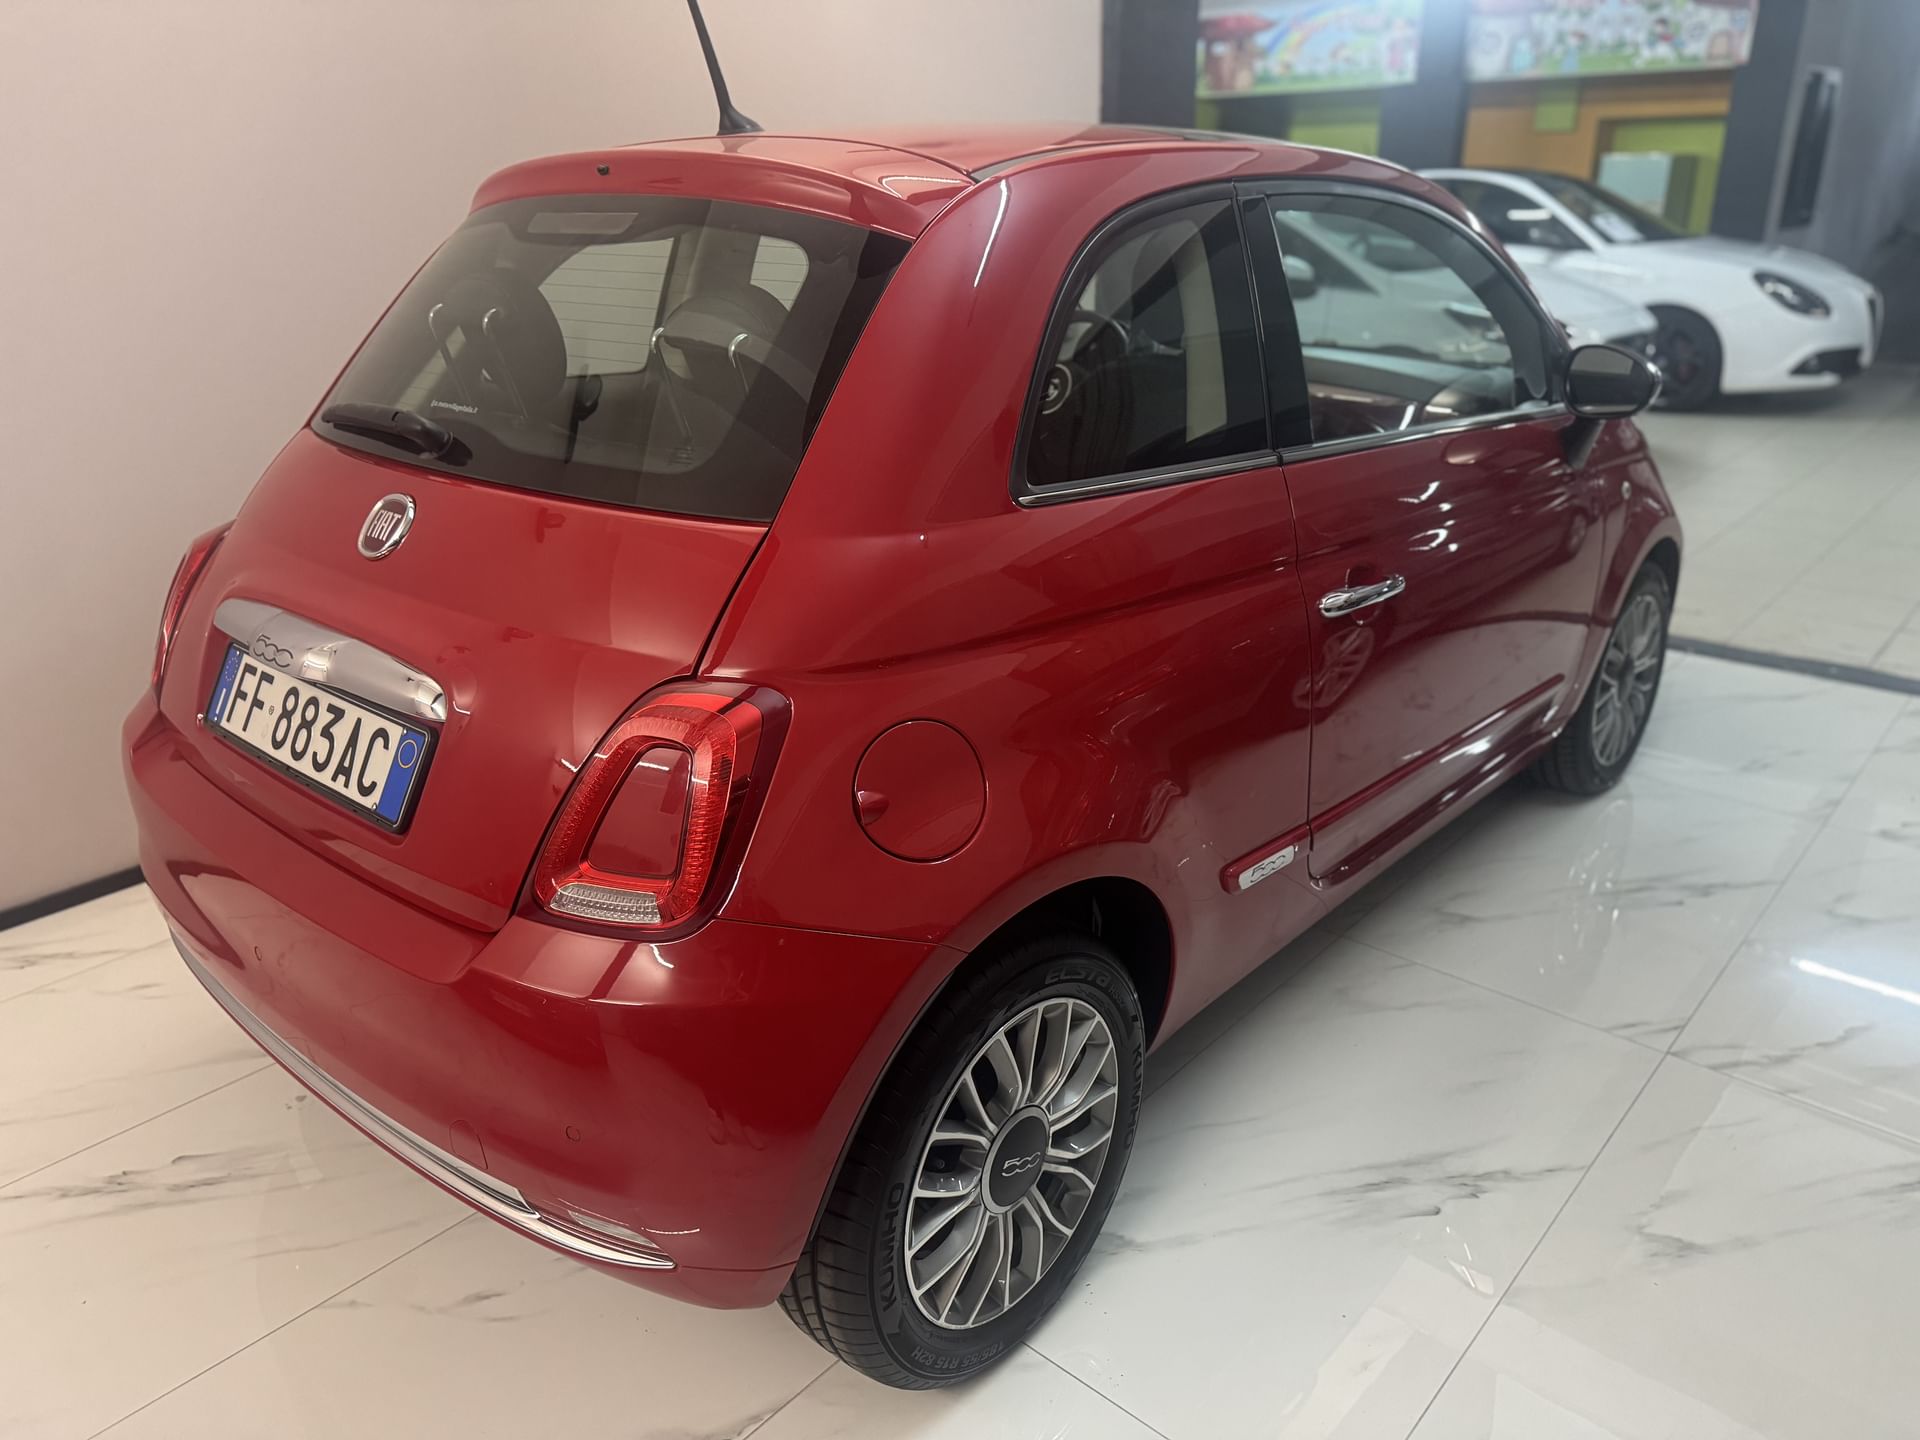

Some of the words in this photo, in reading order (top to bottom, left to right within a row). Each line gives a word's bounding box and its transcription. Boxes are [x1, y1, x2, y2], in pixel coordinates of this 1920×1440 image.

[367, 509, 402, 541] FIAT
[253, 634, 294, 668] 500
[1250, 855, 1286, 883] 500
[1123, 1042, 1142, 1150] KUMHO
[1001, 1152, 1041, 1177] 500
[882, 1183, 904, 1312] KUMHO
